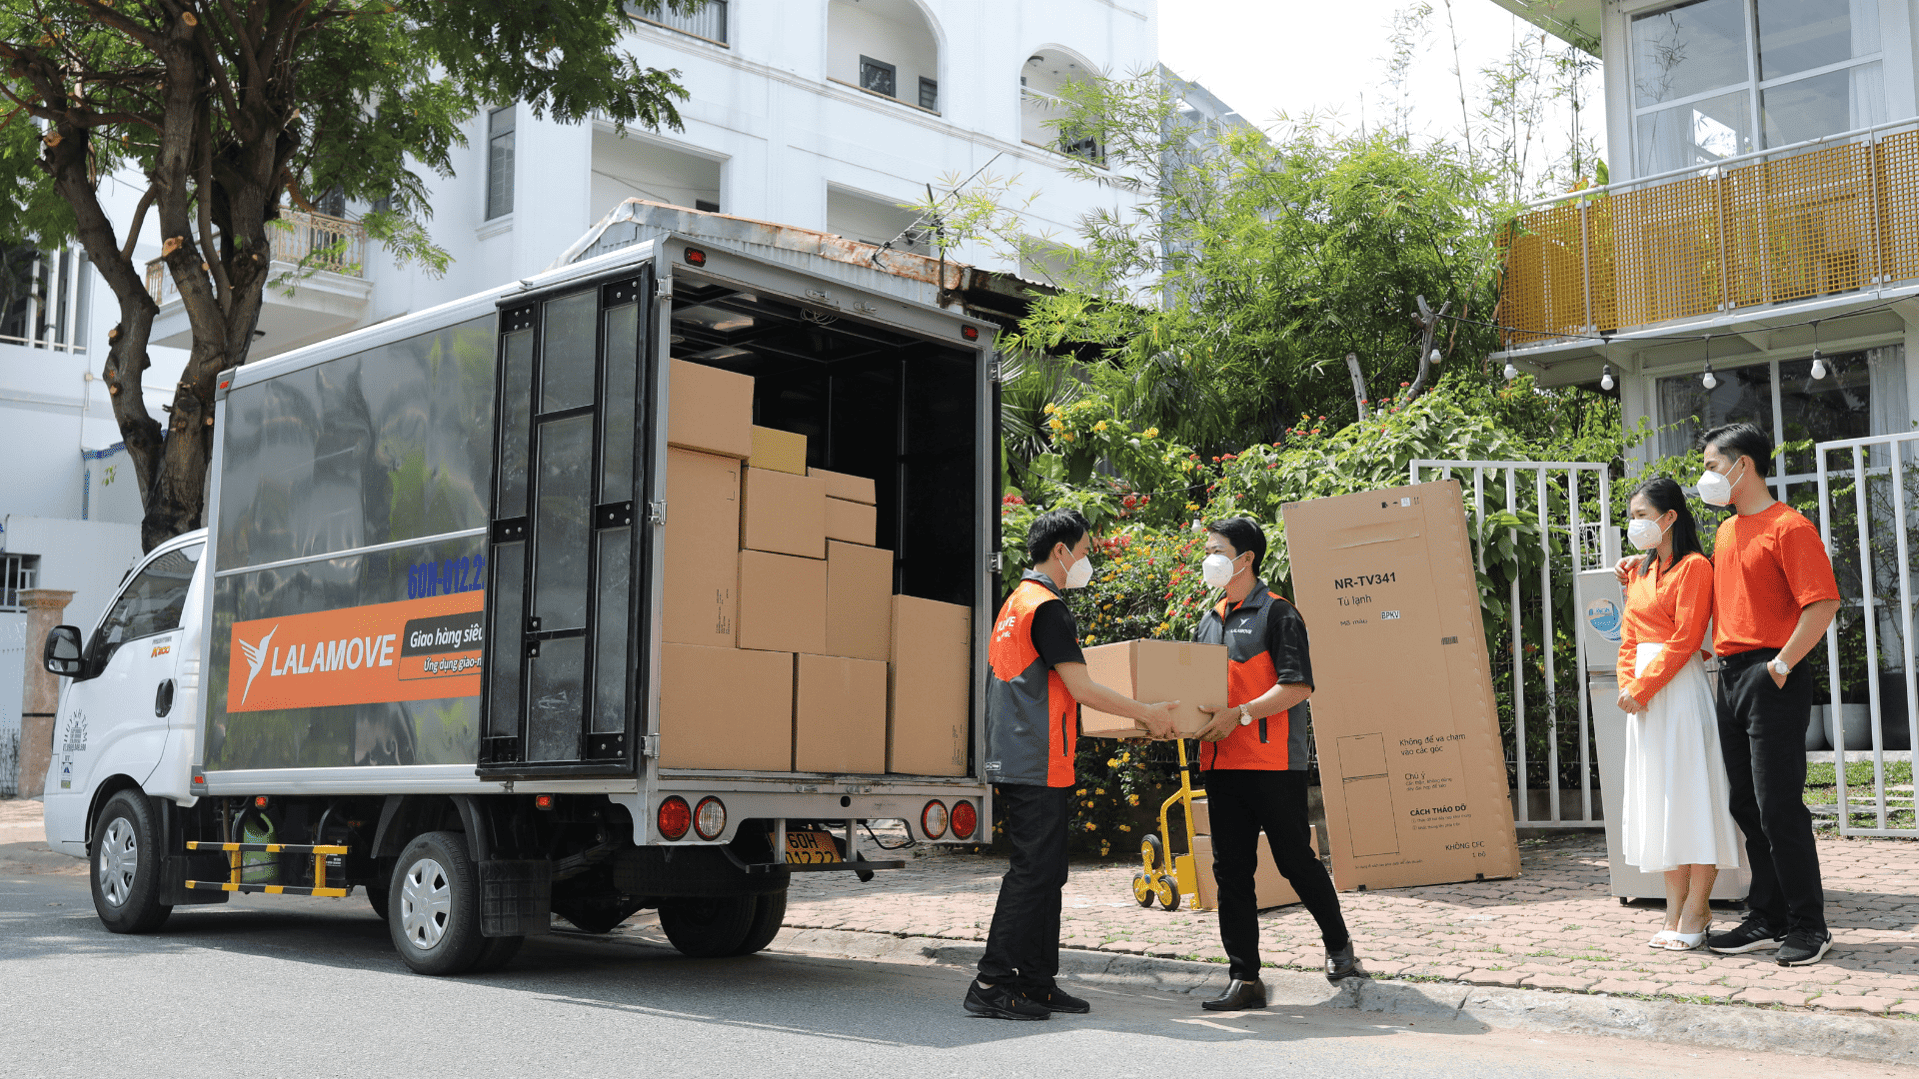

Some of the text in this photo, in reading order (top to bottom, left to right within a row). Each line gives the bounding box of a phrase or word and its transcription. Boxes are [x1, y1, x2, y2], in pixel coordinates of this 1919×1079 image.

[407, 553, 485, 599] 60H-012.2
[1334, 571, 1396, 590] NR-TV341
[1337, 594, 1372, 607] Tủ lạnh
[410, 630, 434, 648] Giao
[435, 627, 462, 649] hàng
[270, 634, 396, 677] LALAMOVE
[424, 656, 439, 674] Ứng
[439, 658, 458, 674] dụng
[1399, 737, 1423, 746] Không
[1400, 744, 1443, 756] vào các góc
[1409, 807, 1431, 817] CÁCH
[1432, 804, 1453, 814] THÁO
[787, 834, 819, 848] 60H
[1445, 840, 1485, 851] KHÔNG CFC
